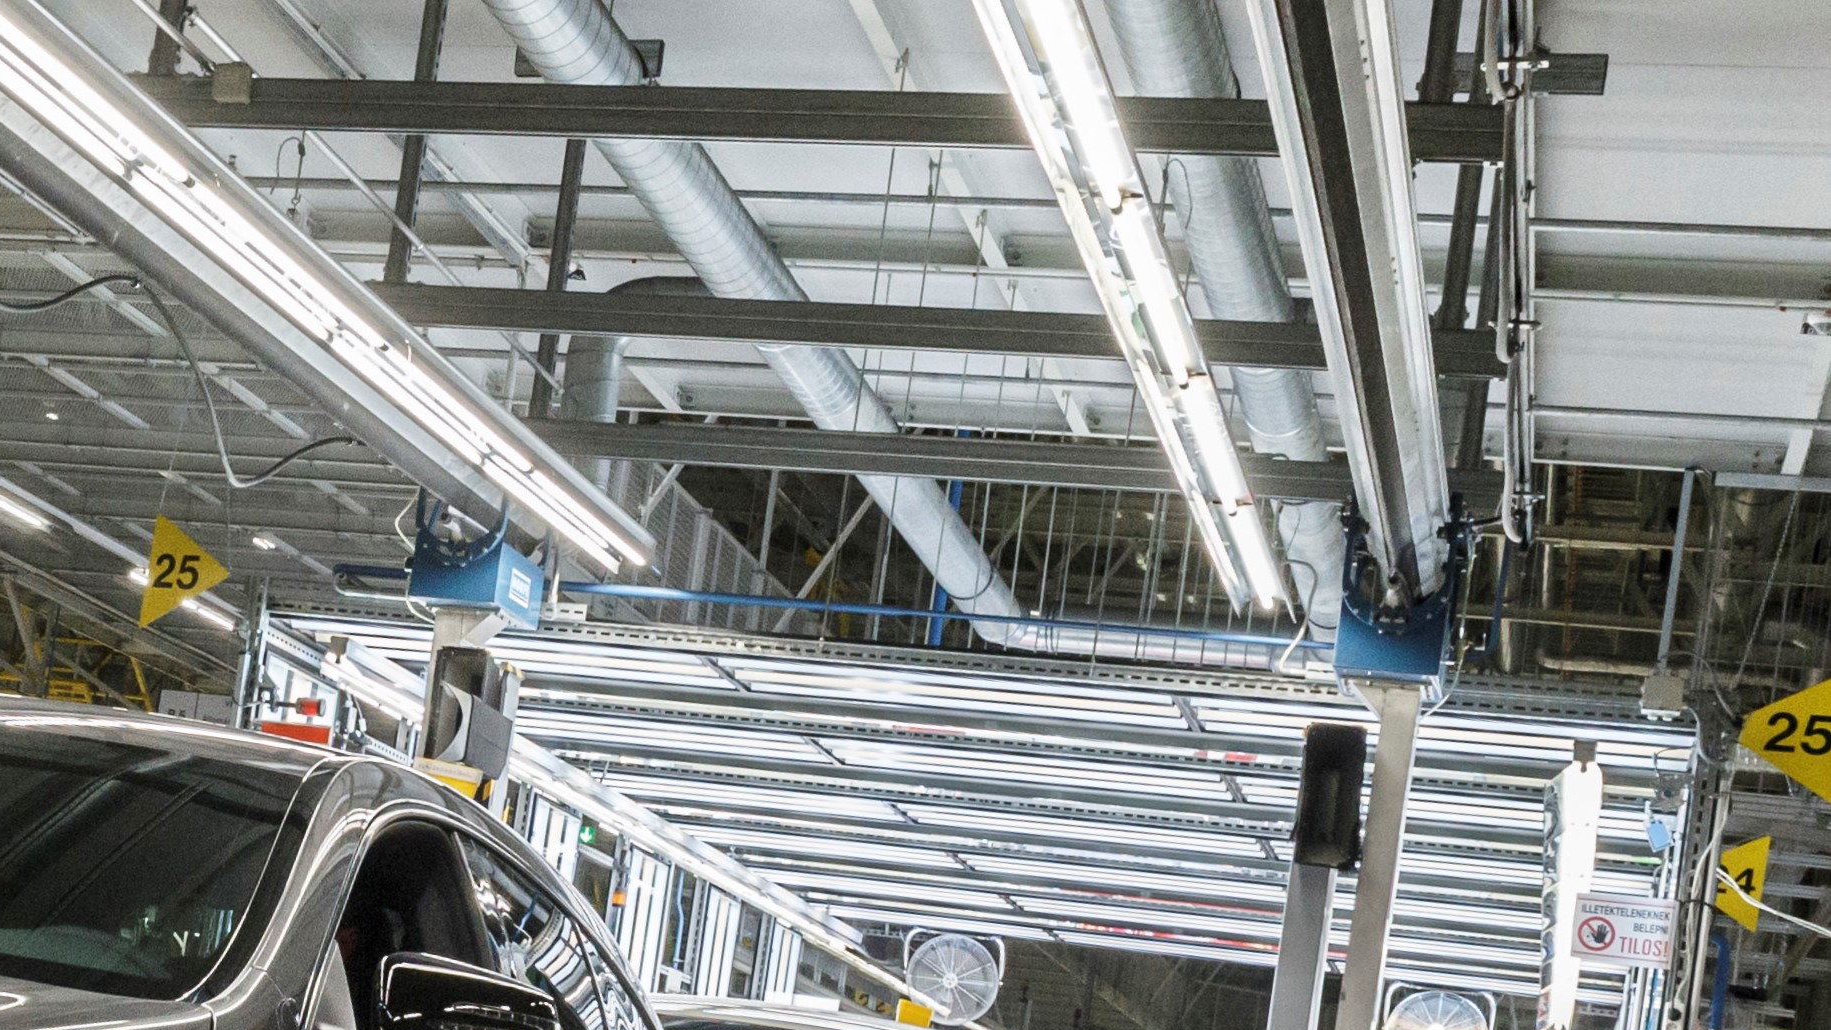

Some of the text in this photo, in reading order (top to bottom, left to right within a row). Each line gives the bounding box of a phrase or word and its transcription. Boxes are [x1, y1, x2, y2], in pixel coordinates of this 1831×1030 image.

[153, 553, 200, 589] 25
[1764, 711, 1831, 756] 25
[1618, 936, 1670, 957] TILOS!
